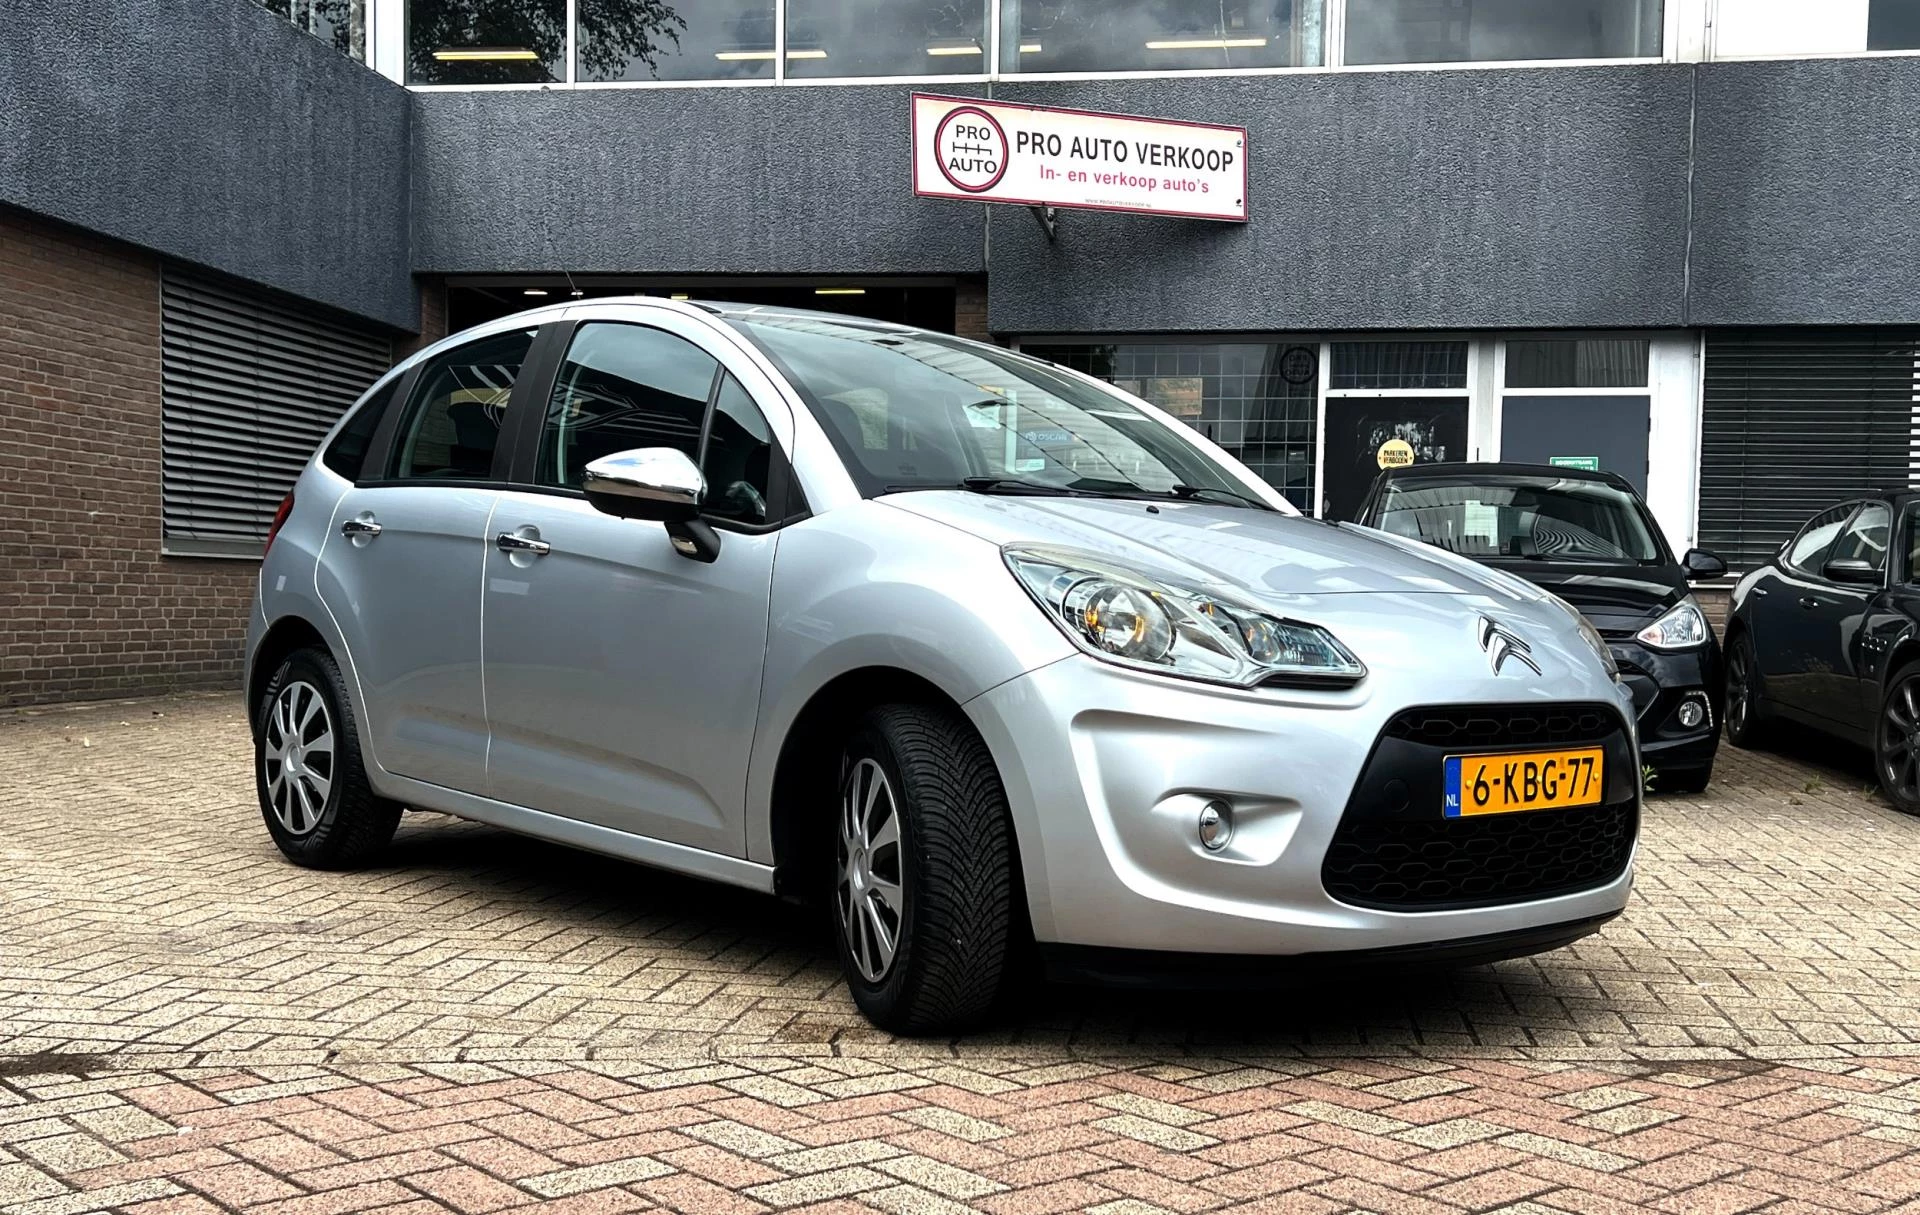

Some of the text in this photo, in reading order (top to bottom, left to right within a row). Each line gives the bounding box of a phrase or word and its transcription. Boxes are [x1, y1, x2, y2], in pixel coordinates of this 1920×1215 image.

[955, 124, 991, 141] PRO
[1016, 130, 1234, 172] PRO AUTO VERKOOP
[948, 156, 998, 174] AUTO
[1039, 164, 1210, 194] In- en verkoop auto's
[1472, 756, 1595, 806] 6-KBG-77
[1446, 794, 1459, 807] NL
